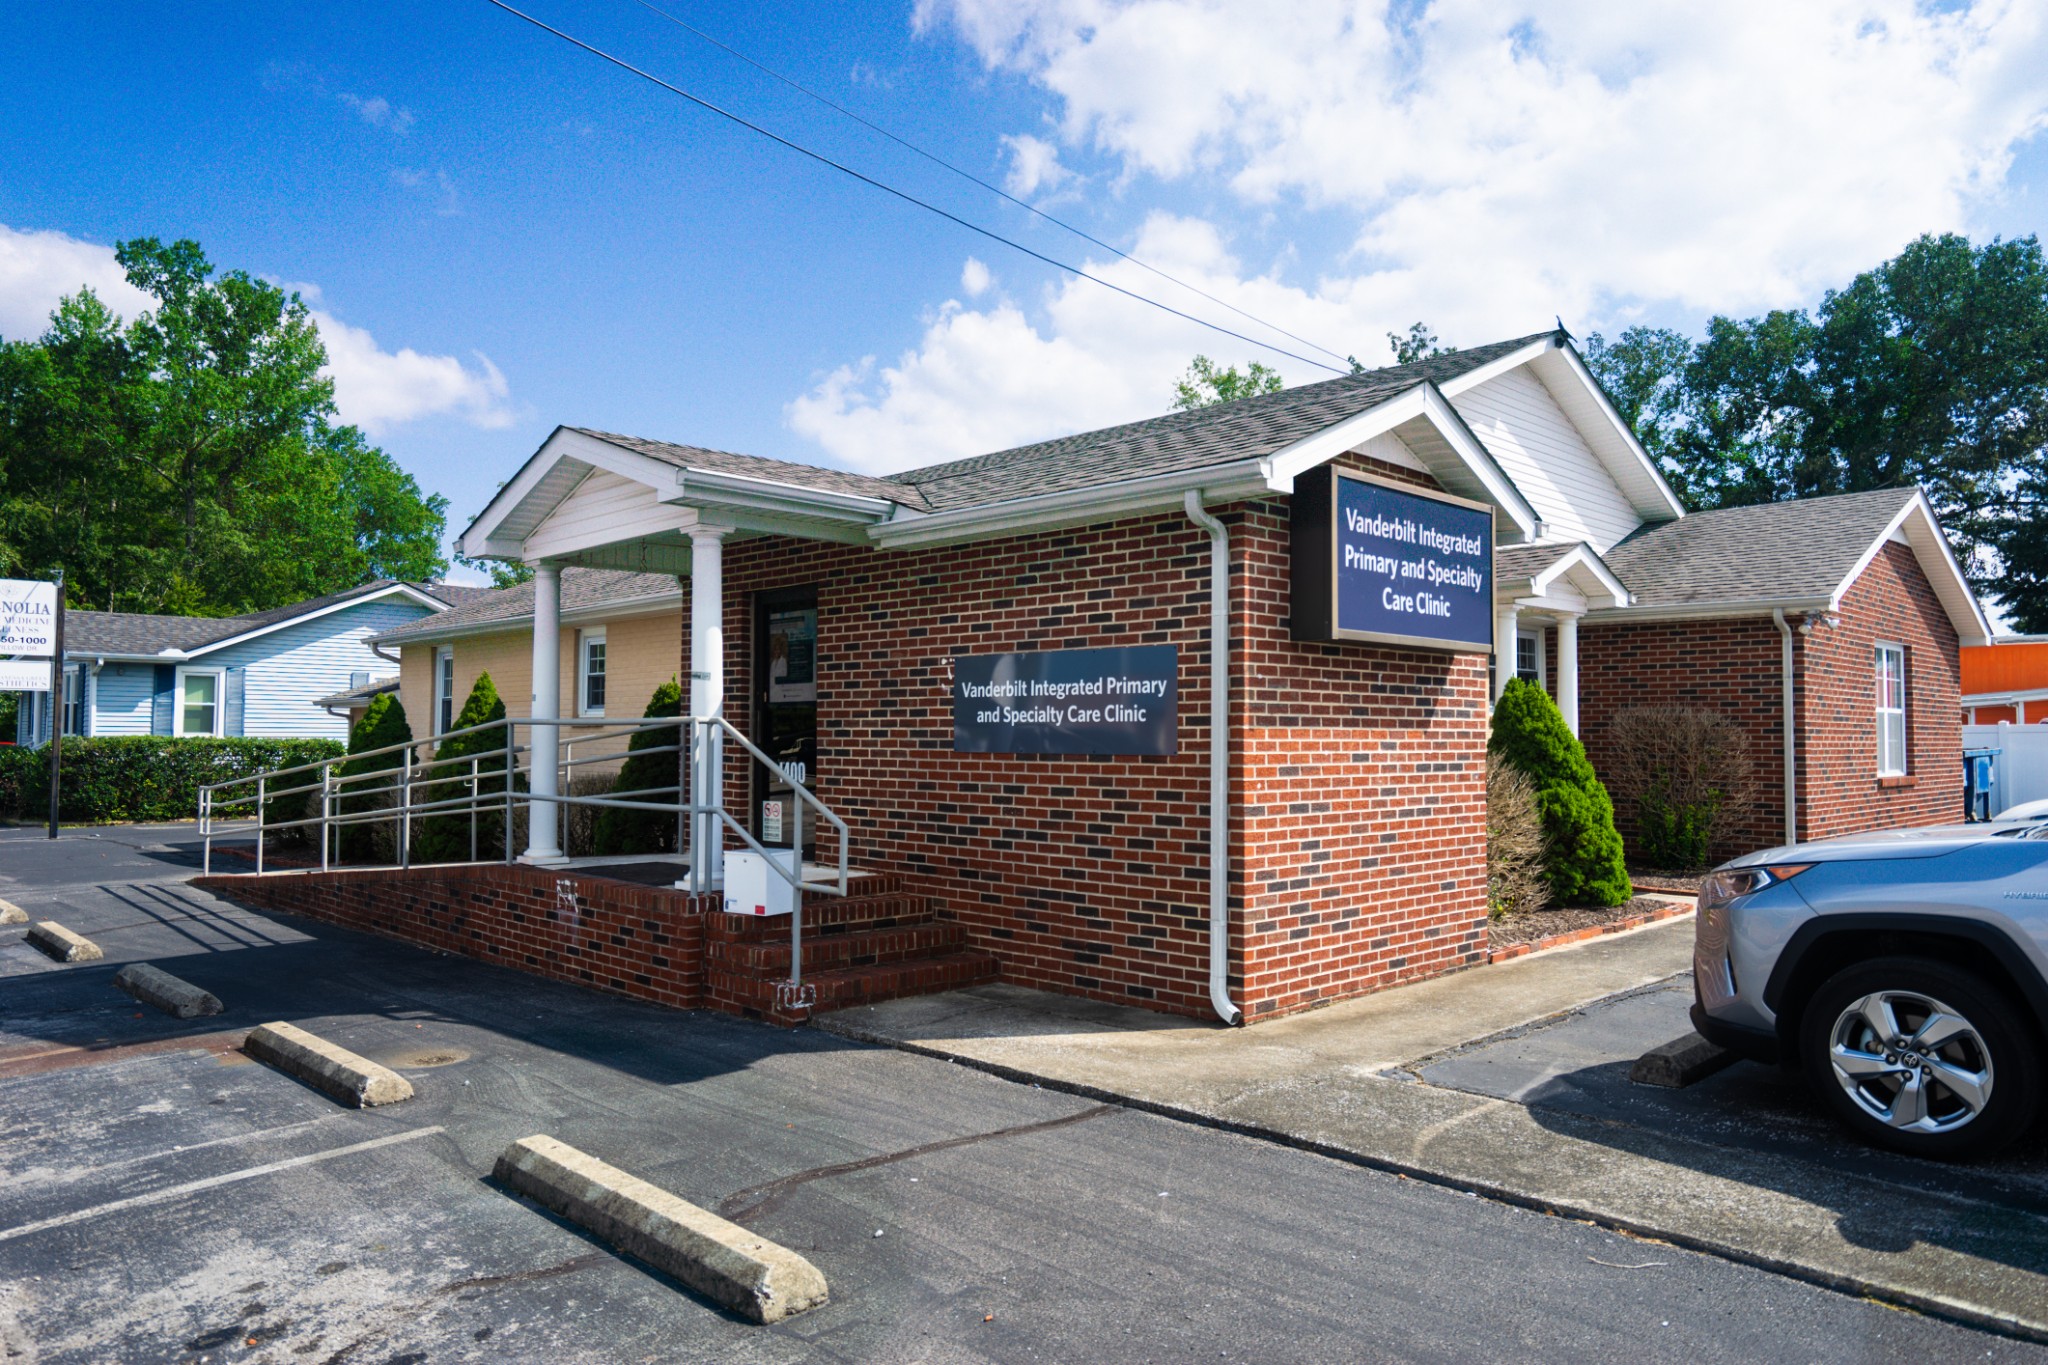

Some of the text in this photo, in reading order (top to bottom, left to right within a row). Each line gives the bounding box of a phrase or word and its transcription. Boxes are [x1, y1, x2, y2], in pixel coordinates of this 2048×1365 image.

[1345, 507, 1481, 555] Vanderbilt Integrated
[1345, 544, 1482, 593] Primary and Specialty
[0, 601, 51, 615] NOLIA
[1382, 587, 1451, 617] Care Clinic
[962, 677, 1168, 700] Vanderbilt Integrated Primary
[976, 704, 1147, 726] and Specialty Care Clinic
